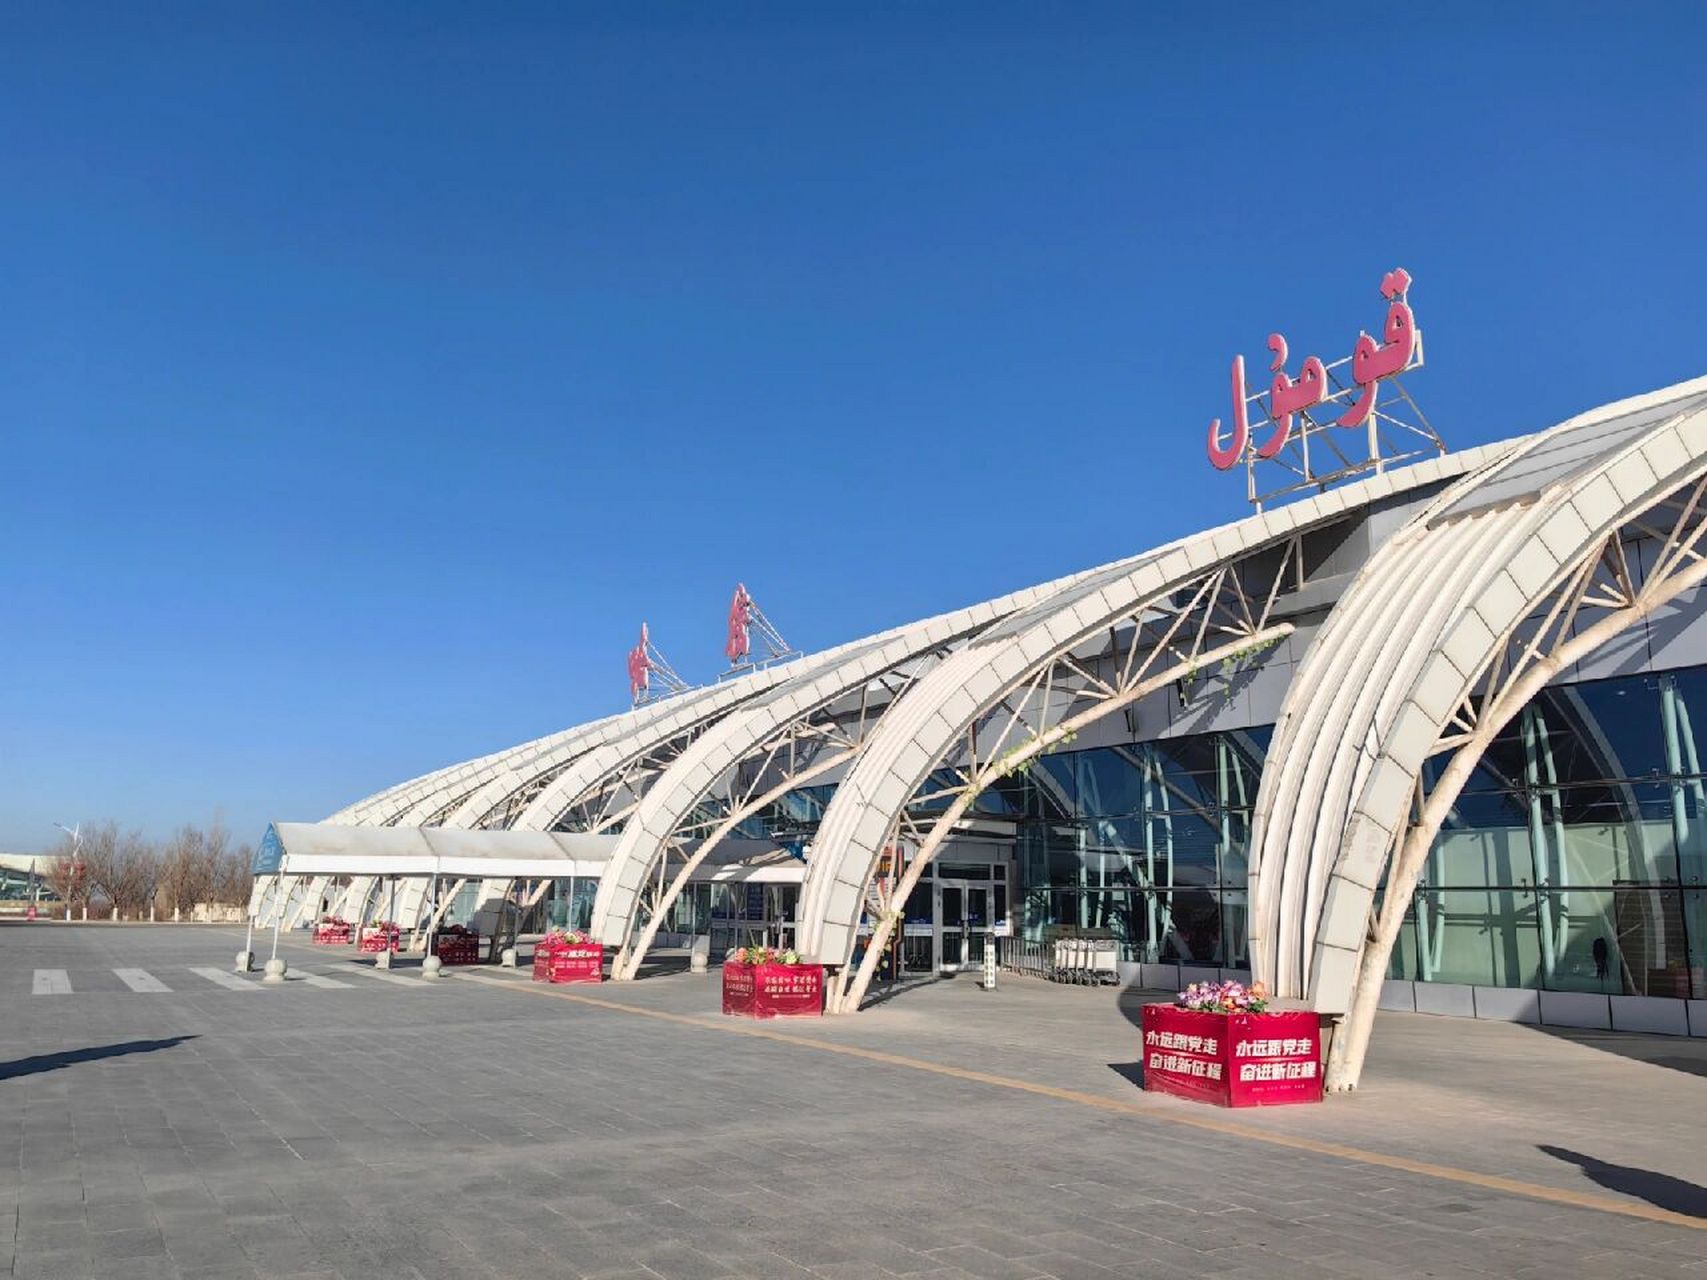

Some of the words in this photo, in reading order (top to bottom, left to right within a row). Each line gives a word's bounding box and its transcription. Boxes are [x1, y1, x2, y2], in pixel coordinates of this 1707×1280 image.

[1146, 1031, 1217, 1054] 永远跟党走
[1236, 1038, 1312, 1057] 永远跟党走
[1150, 1054, 1222, 1080] 奋进新征程
[1240, 1061, 1316, 1081] 奋进新征程
